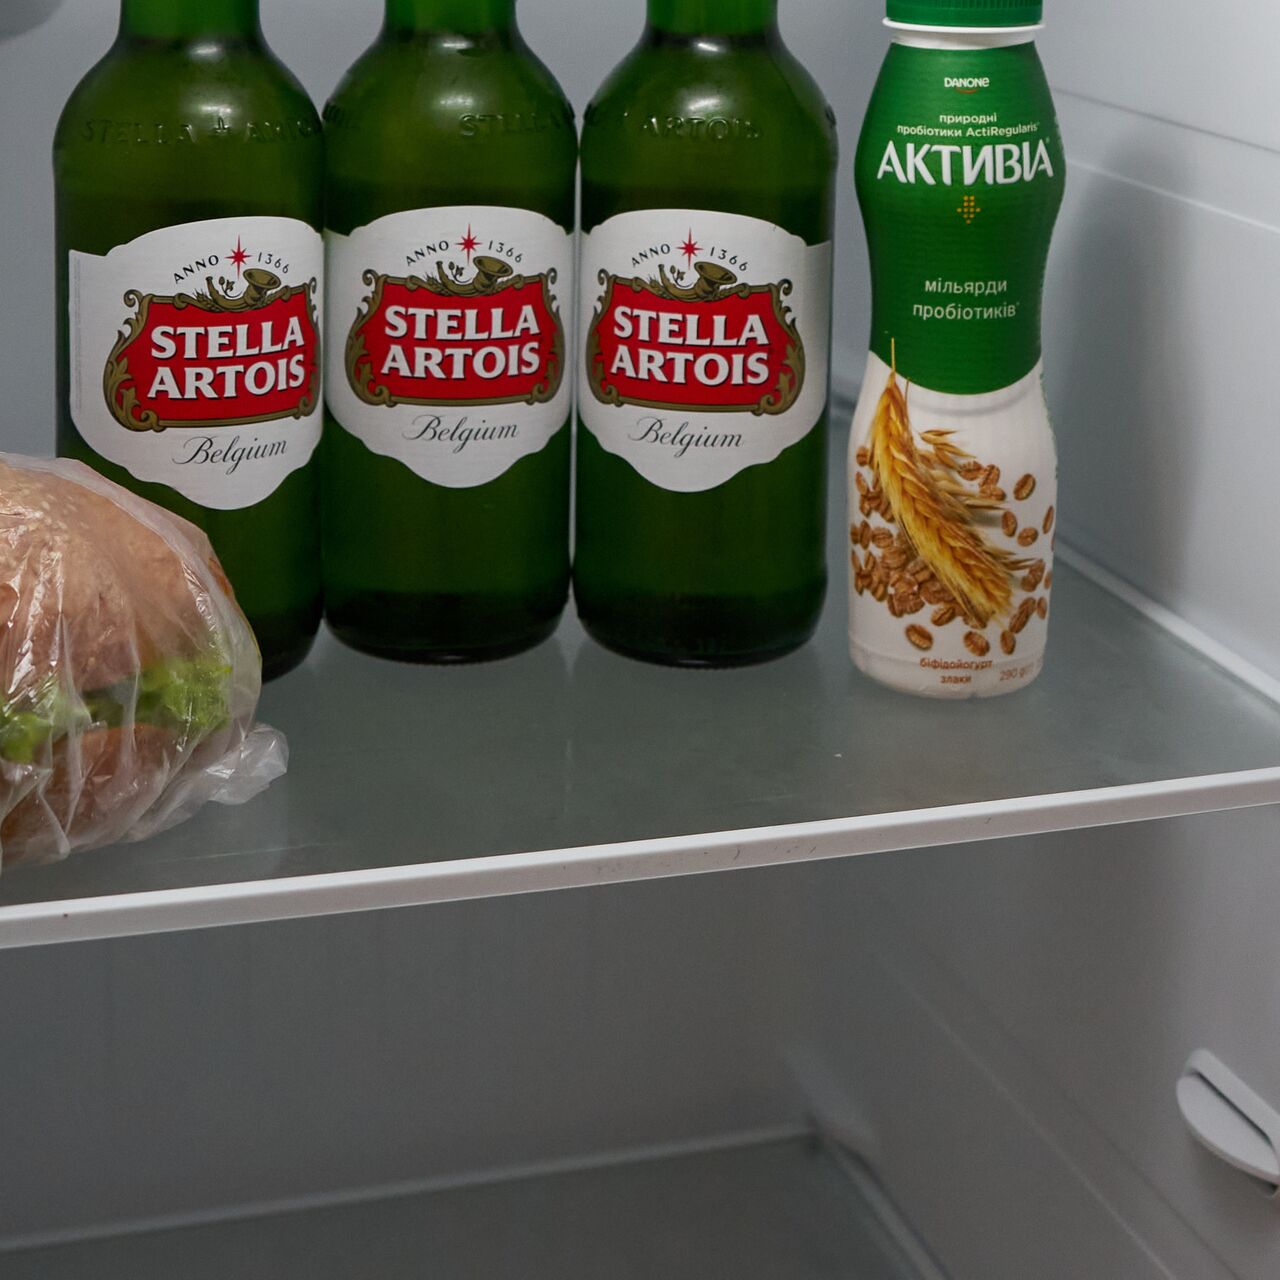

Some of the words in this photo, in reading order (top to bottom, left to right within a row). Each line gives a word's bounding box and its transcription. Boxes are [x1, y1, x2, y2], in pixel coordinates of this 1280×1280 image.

[896, 123, 962, 138] пробіотики
[939, 112, 997, 125] природні
[173, 254, 219, 284] ANNO
[257, 251, 290, 274] 1366
[405, 240, 450, 266] ANNO
[487, 239, 523, 264] 1366
[631, 243, 671, 268] ANNO
[710, 245, 748, 272] 1366
[924, 278, 1008, 296] мільярди
[150, 316, 305, 360] STELLA
[384, 305, 539, 341] STELLA
[613, 305, 769, 347] STELLA
[147, 354, 305, 400] ARTOIS
[381, 341, 540, 379] ARTOIS
[610, 344, 769, 387] ARTOIS
[401, 413, 519, 454] Belgium
[627, 415, 744, 458] Belgium
[172, 434, 287, 476] Belgium
